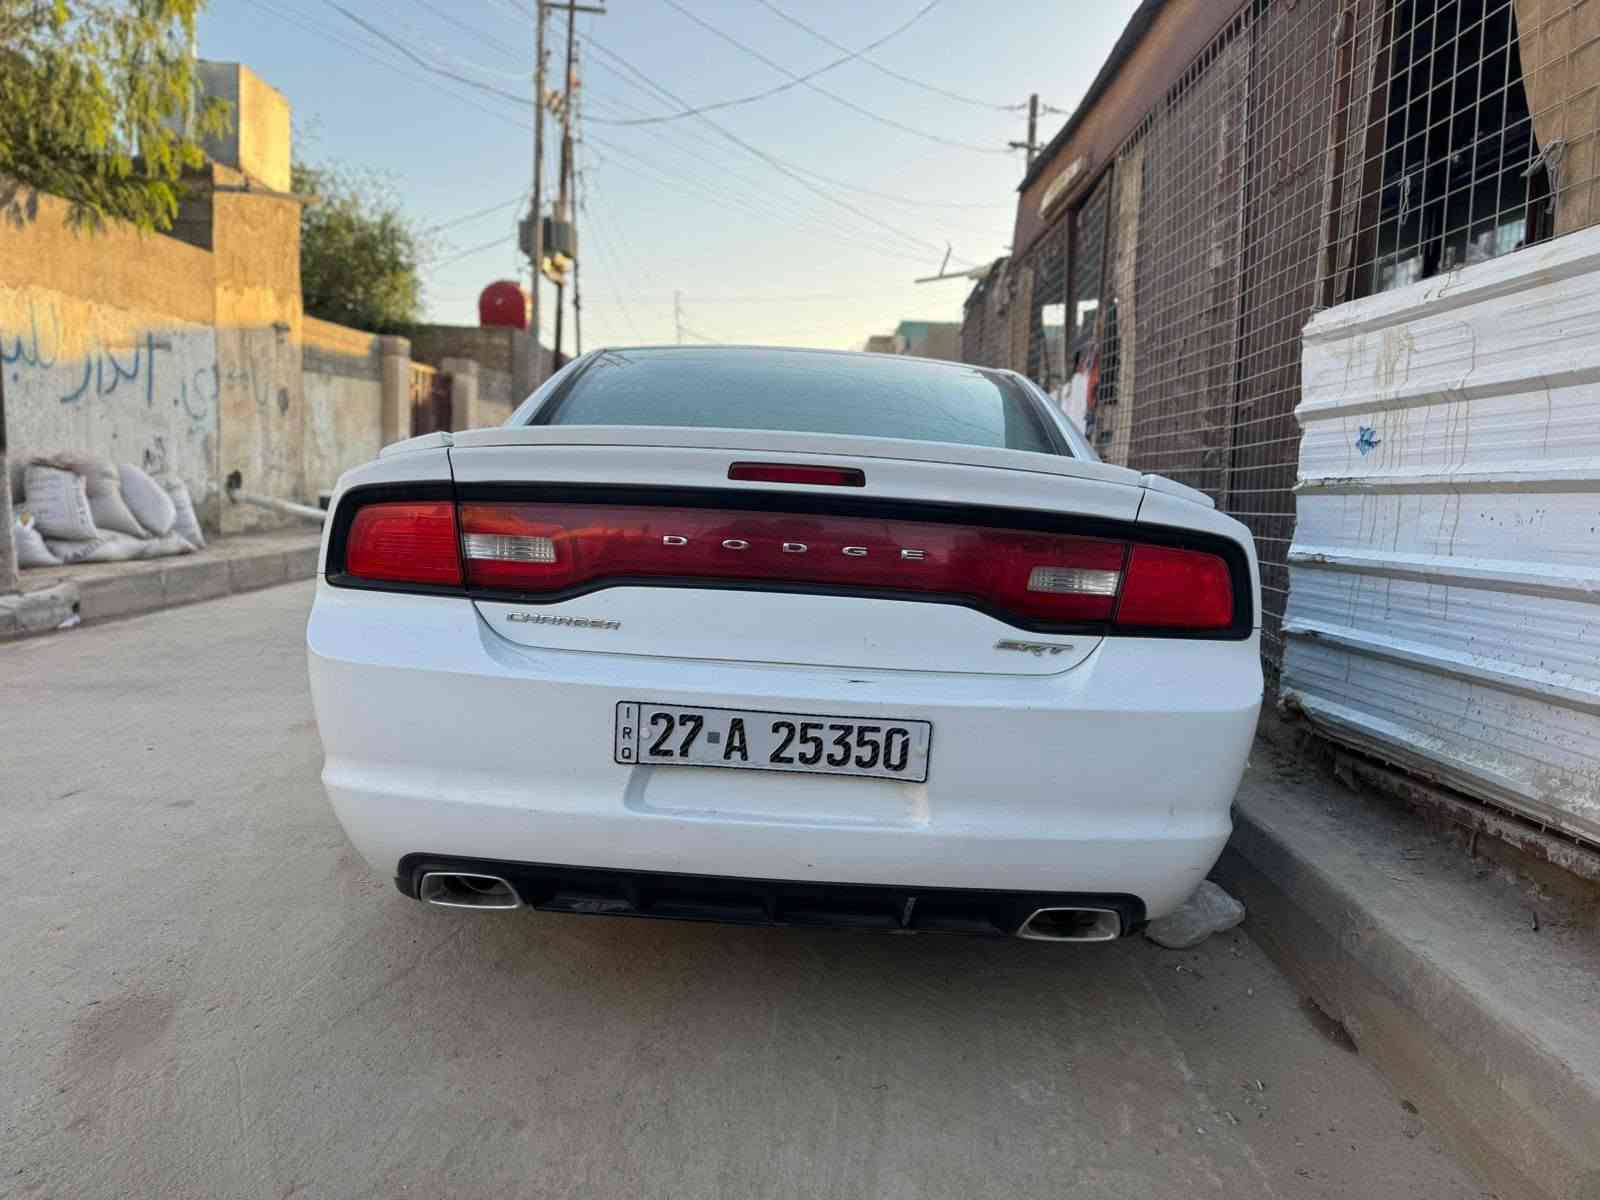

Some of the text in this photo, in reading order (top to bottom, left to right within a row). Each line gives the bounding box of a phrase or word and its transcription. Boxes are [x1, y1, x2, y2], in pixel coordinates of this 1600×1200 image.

[662, 535, 927, 560] DODGE
[506, 612, 621, 630] CHARGER
[996, 640, 1074, 656] SRT
[649, 712, 910, 772] 27 A 25350
